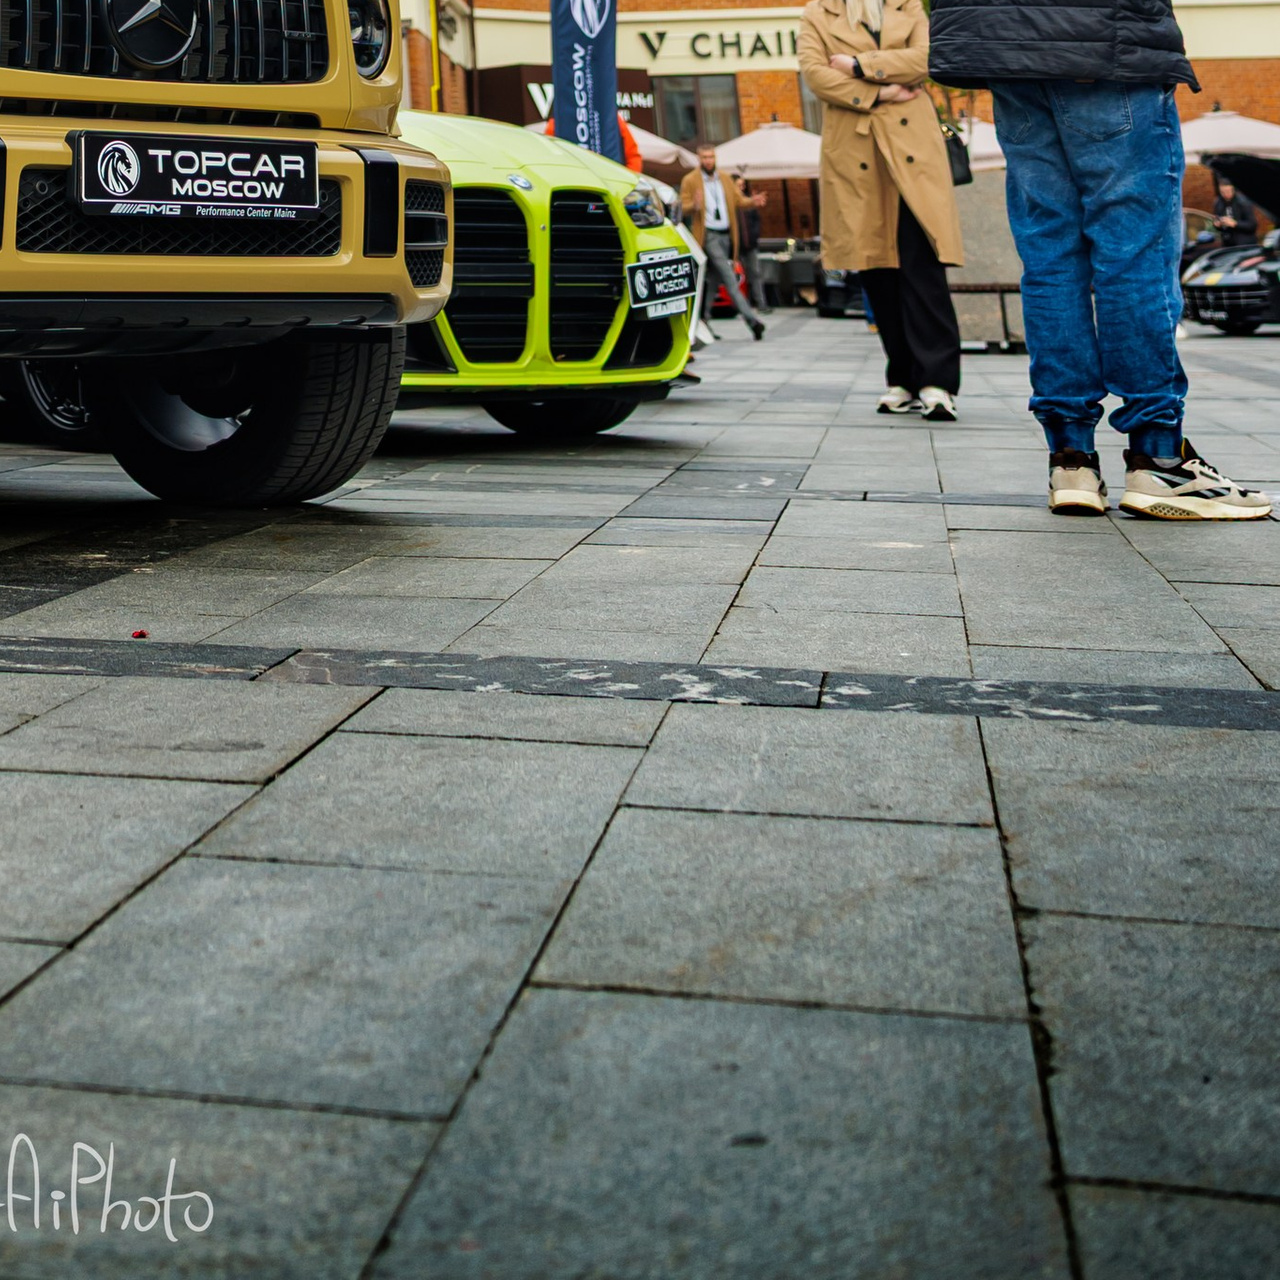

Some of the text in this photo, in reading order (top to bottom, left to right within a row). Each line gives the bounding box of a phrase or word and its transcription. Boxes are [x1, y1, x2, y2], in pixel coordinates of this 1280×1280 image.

[147, 148, 305, 179] TOPCAR
[171, 178, 285, 199] MOSCOW
[195, 205, 246, 218] Performance
[246, 206, 272, 217] Center
[273, 207, 297, 219] Mainz
[647, 262, 691, 281] TOPCAR
[655, 277, 690, 295] MOSCOW
